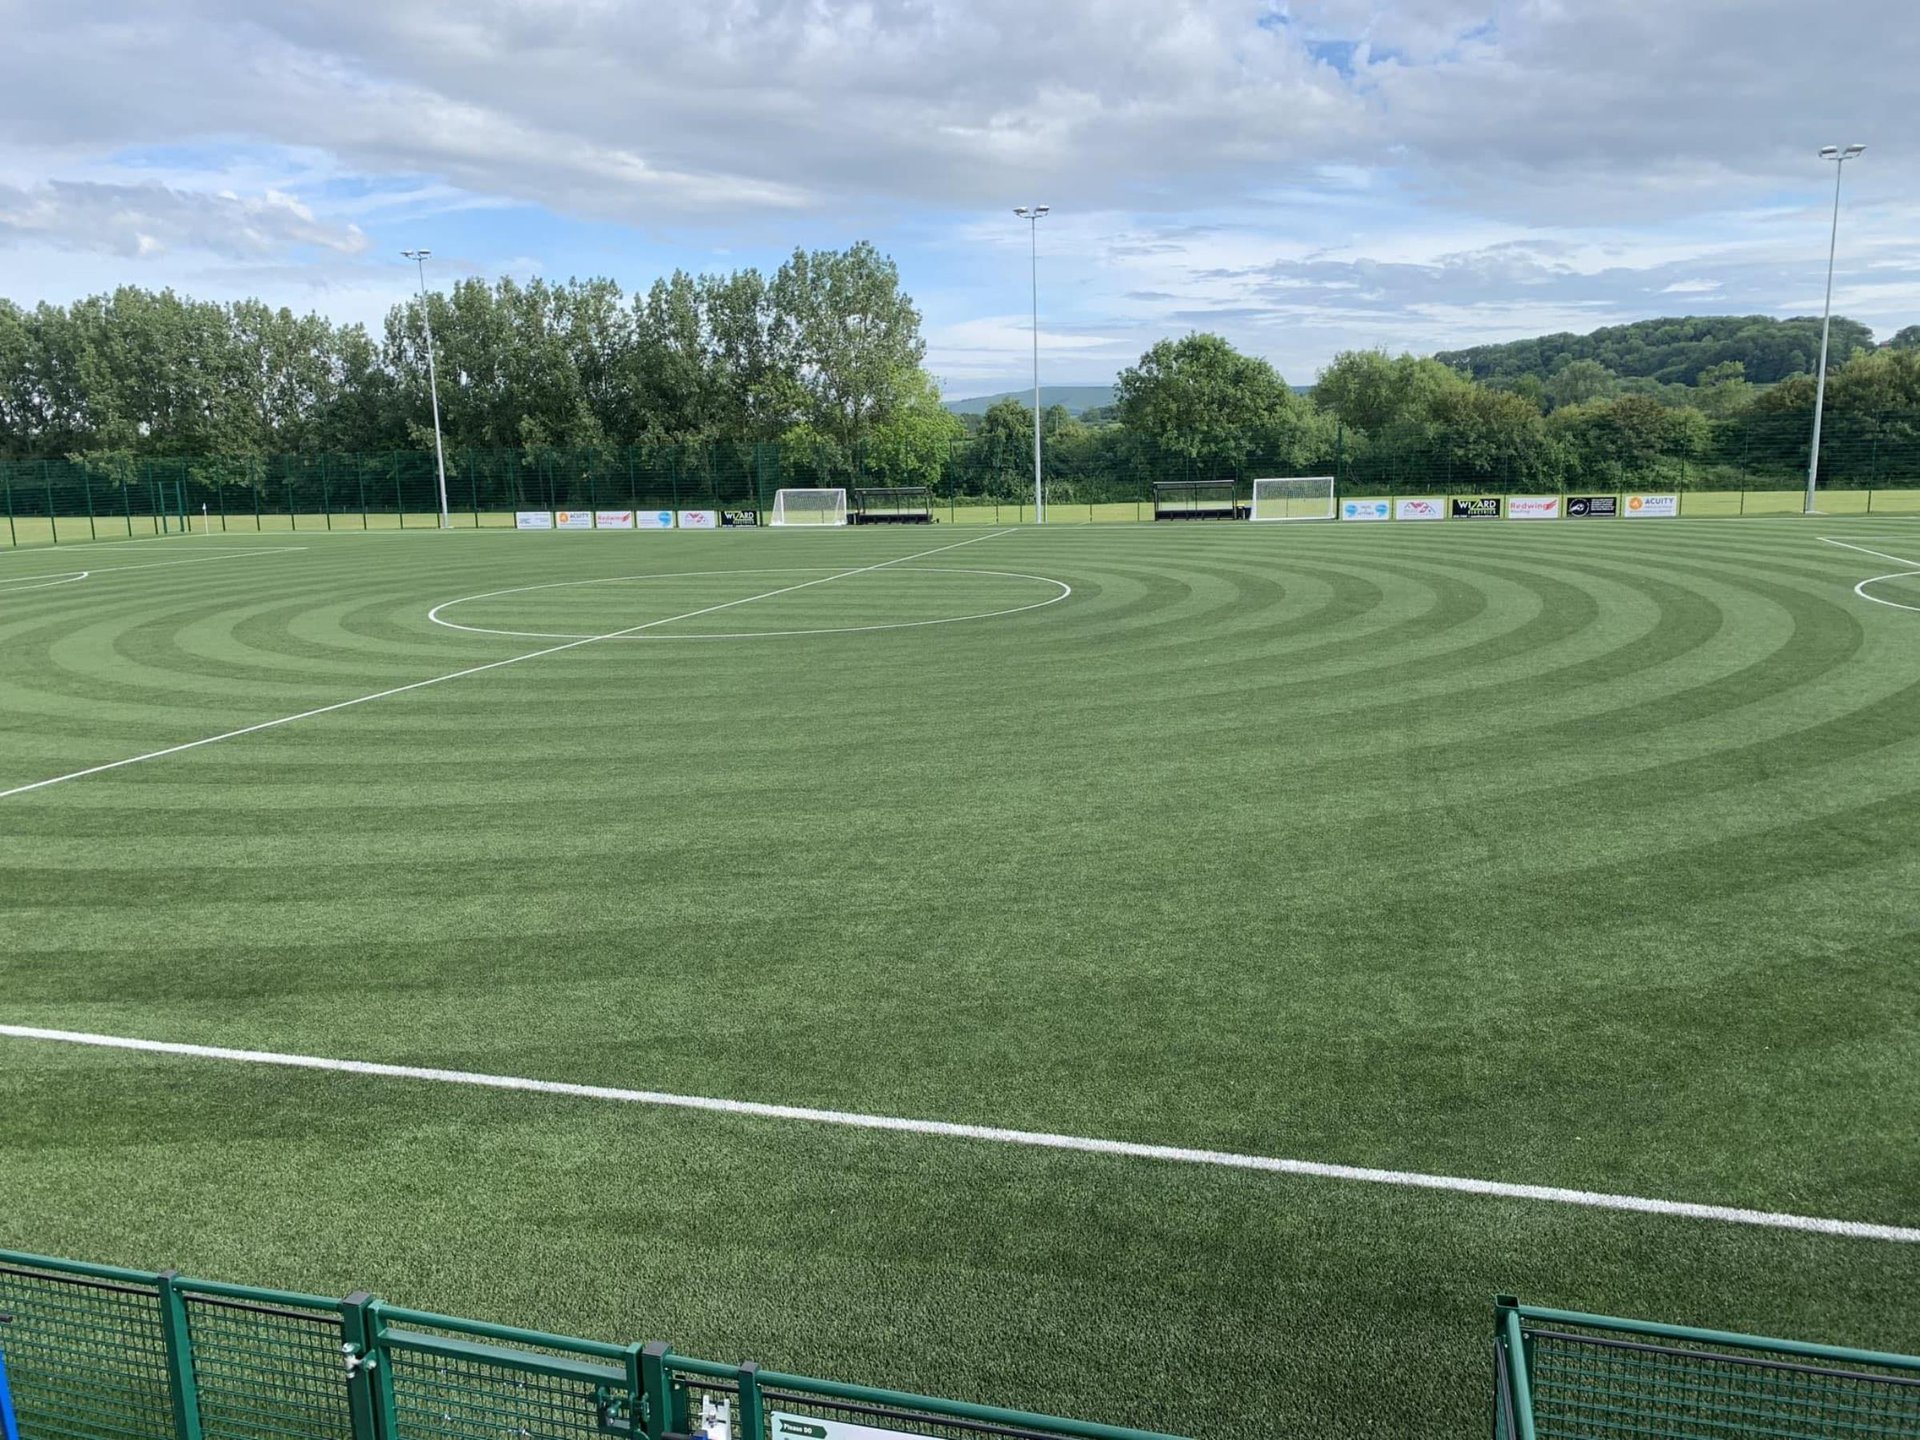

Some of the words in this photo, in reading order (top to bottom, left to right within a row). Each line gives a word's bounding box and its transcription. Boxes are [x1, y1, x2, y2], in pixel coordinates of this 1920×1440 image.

[1458, 500, 1496, 509] WIZARD
[725, 511, 754, 520] WIZARD
[784, 1423, 802, 1432] Please
